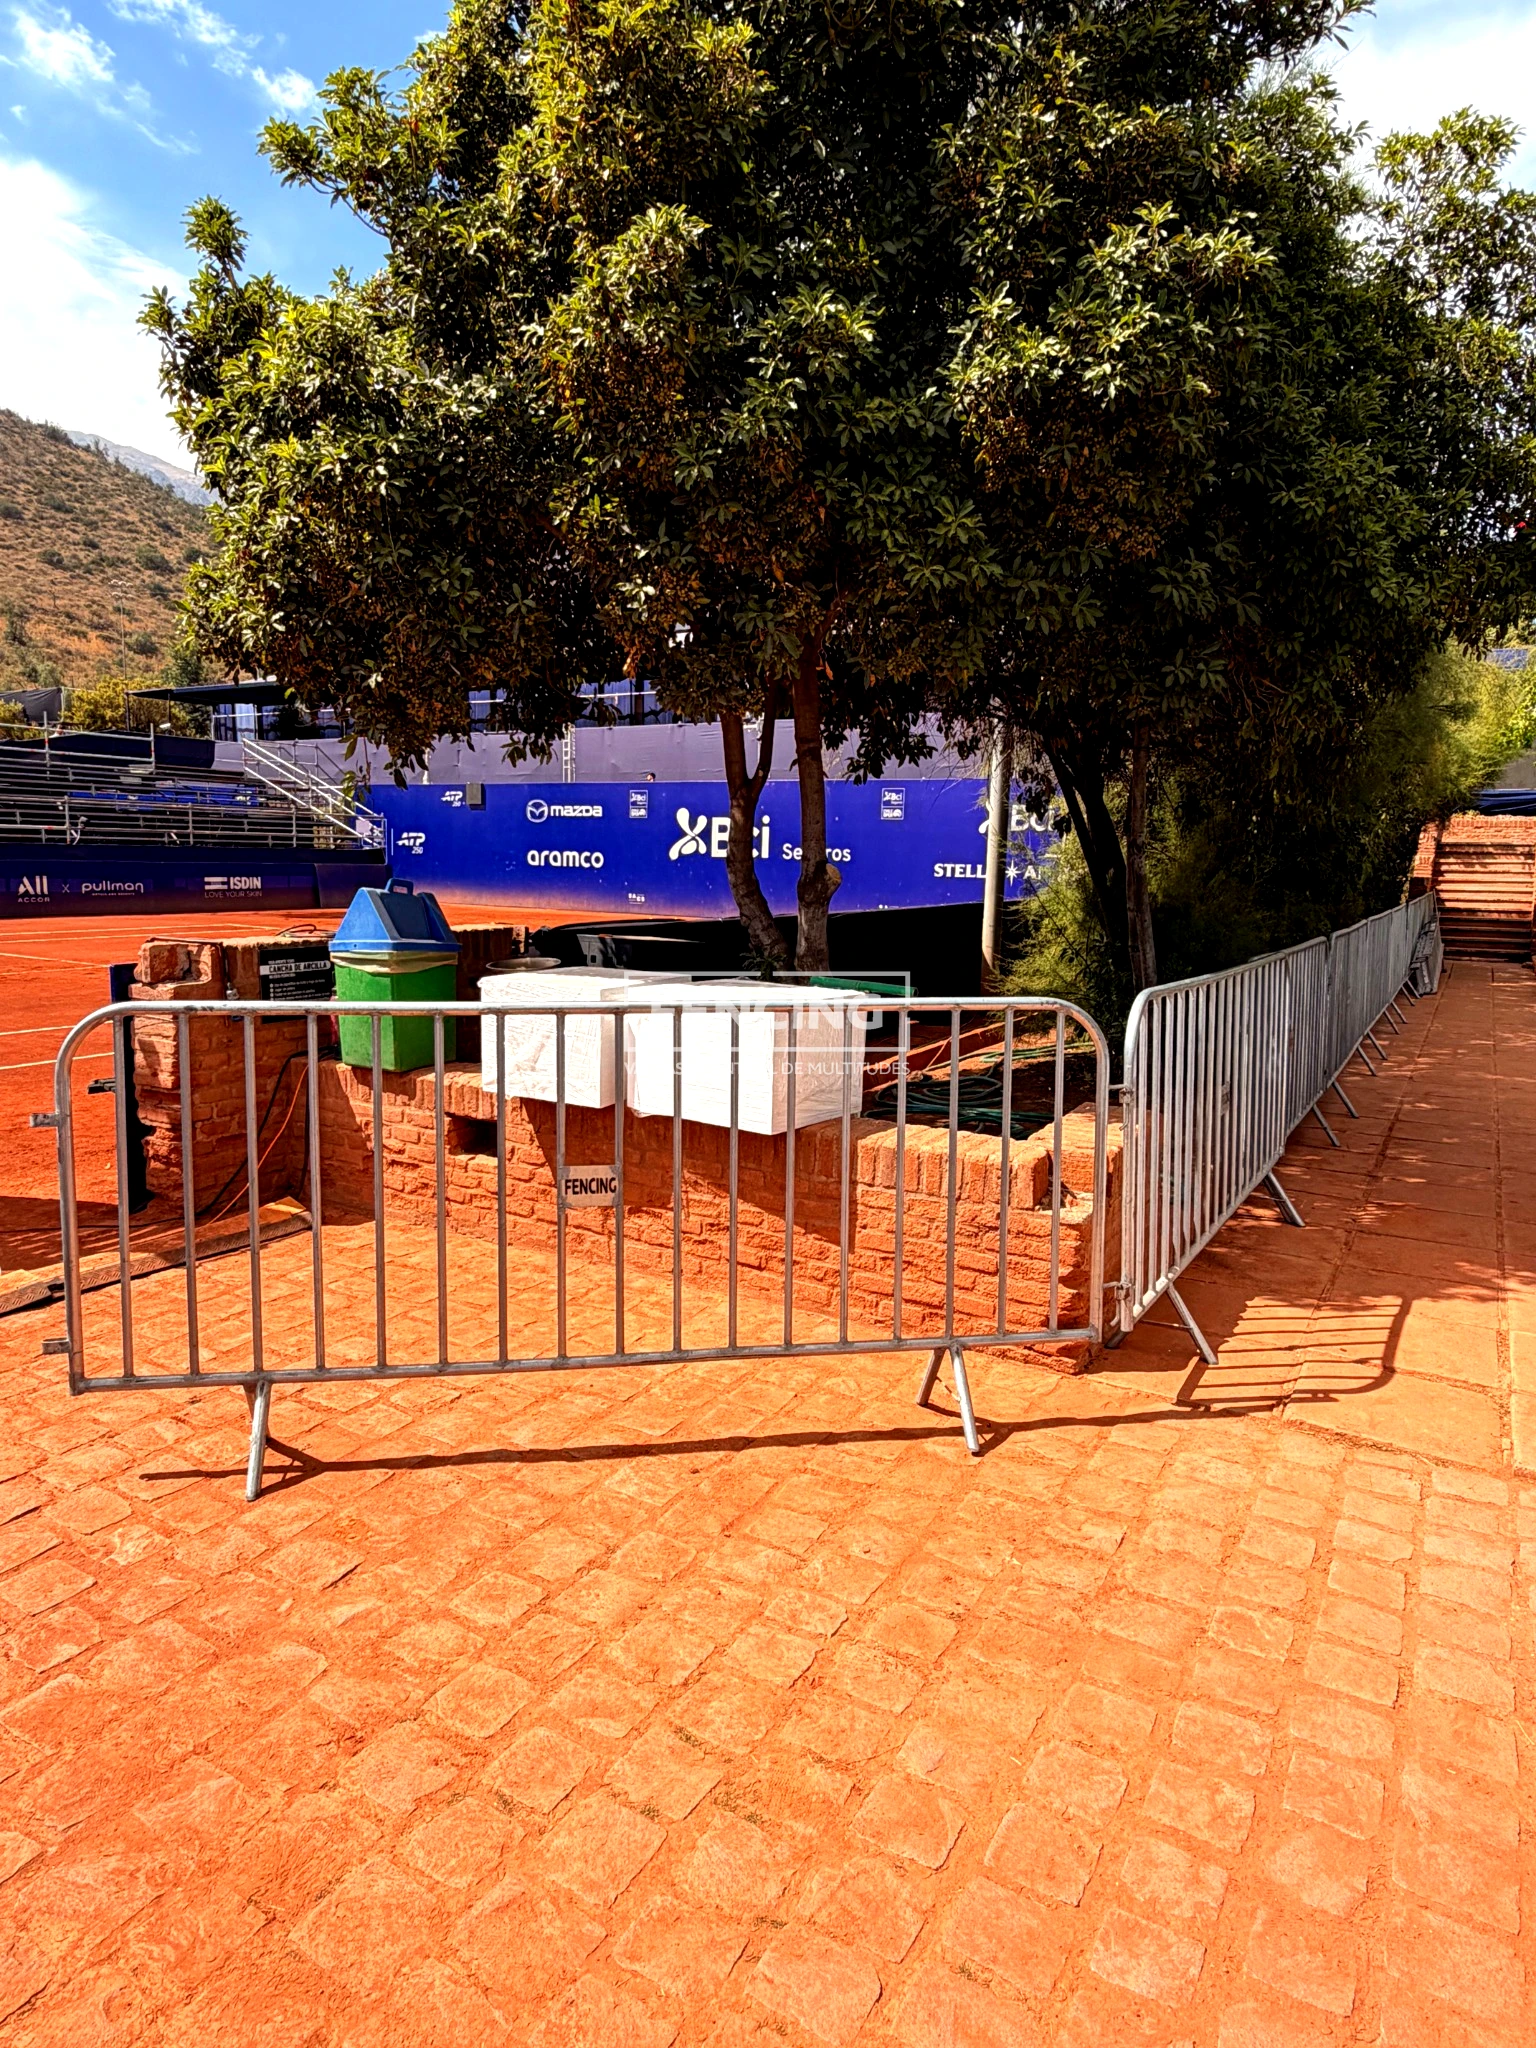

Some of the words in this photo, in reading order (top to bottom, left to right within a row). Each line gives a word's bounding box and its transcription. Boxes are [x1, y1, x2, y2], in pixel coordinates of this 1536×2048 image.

[441, 790, 463, 801] ATP
[550, 804, 603, 818] mazda
[396, 832, 426, 846] ATP
[411, 846, 423, 854] 250
[782, 843, 852, 863] Seros
[527, 849, 604, 869] aramco
[933, 863, 988, 879] STELL
[81, 880, 144, 895] pullman
[230, 876, 262, 890] ISDIN
[205, 891, 224, 899] LOVE
[226, 890, 245, 898] YOUR
[294, 963, 302, 971] DE
[564, 1176, 617, 1196] FENCING
